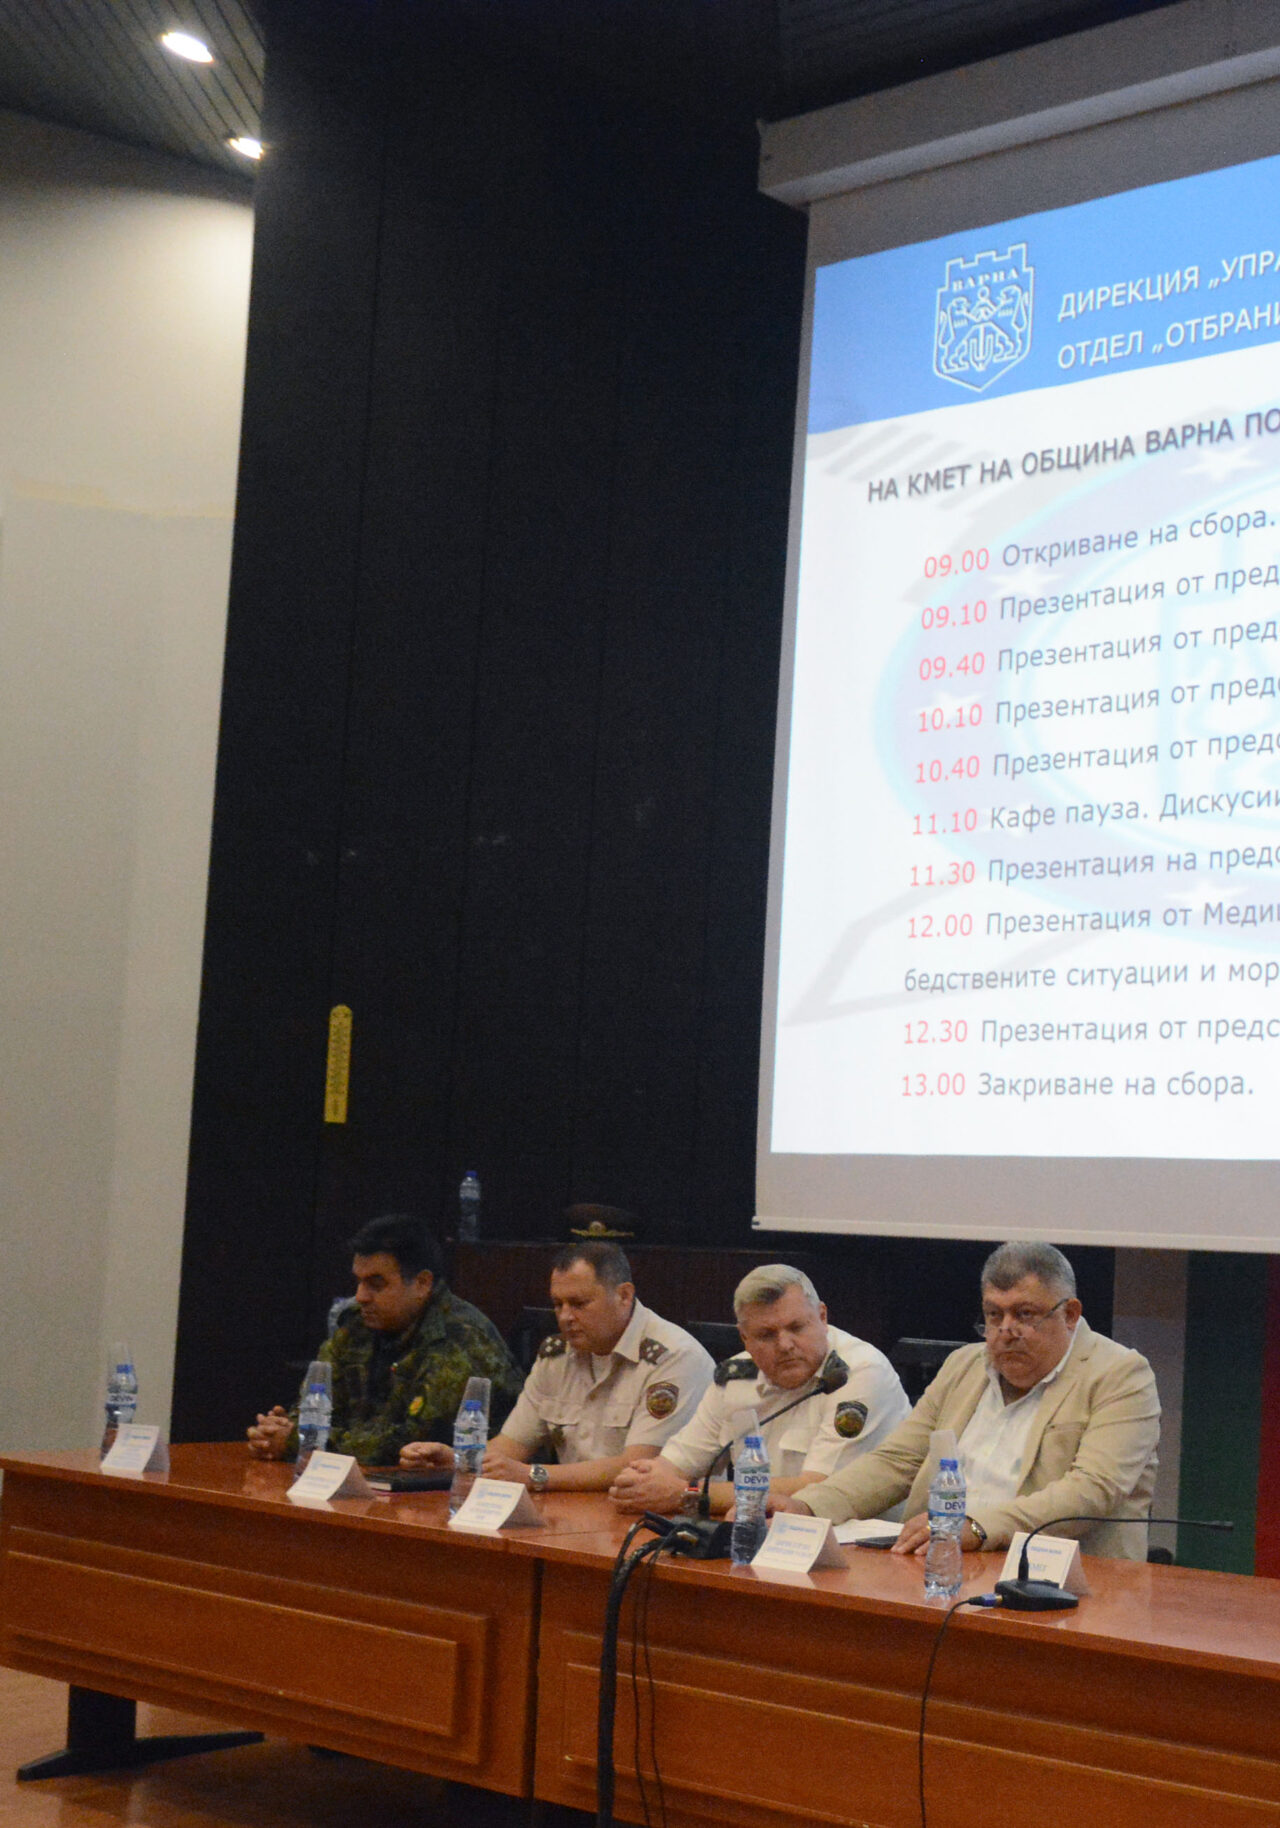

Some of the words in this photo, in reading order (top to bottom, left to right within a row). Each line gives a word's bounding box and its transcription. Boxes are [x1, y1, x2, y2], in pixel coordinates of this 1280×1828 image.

[952, 267, 1019, 293] ВАРНА
[1058, 265, 1200, 321] ДИРЕКЦИЯ
[1058, 330, 1144, 369] ОТДЕЛ
[867, 477, 900, 504] НА
[907, 462, 973, 498] КМЕТ
[978, 457, 1014, 486] НА
[1020, 434, 1137, 479] ОБЩИНА
[1144, 417, 1236, 456] ВАРНА
[922, 546, 992, 580] 09.00
[1001, 529, 1139, 568] Откриване
[1149, 523, 1179, 547] на
[1188, 509, 1276, 539] сбора.
[920, 598, 989, 632] 09.10
[999, 581, 1165, 622] Презентация
[1176, 575, 1205, 596] от
[918, 650, 987, 683] 09.40
[997, 634, 1162, 675] Презентация
[1173, 629, 1203, 650] от
[917, 701, 985, 734] 10.10
[995, 688, 1160, 727] Презентация
[1170, 684, 1201, 705] от
[914, 753, 982, 785] 10.40
[992, 743, 1159, 777] Презентация
[1169, 739, 1198, 760] от
[911, 806, 980, 837] 11.10
[990, 803, 1056, 834] Кафе
[1065, 801, 1148, 828] пауза.
[909, 859, 977, 889] 11.30
[988, 854, 1155, 887] Презентация
[1166, 851, 1197, 872] на
[907, 912, 974, 940] 12.00
[986, 908, 1152, 941] Презентация
[1162, 907, 1193, 927] от
[904, 968, 1056, 995] бедствените
[1066, 964, 1188, 992] ситуации
[1200, 964, 1216, 982] и
[902, 1018, 969, 1046] 12.30
[981, 1019, 1148, 1049] Презентация
[1158, 1020, 1188, 1040] от
[900, 1070, 967, 1098] 13.00
[977, 1071, 1113, 1103] Закриване
[1124, 1076, 1156, 1096] на
[1166, 1070, 1254, 1103] сбора.
